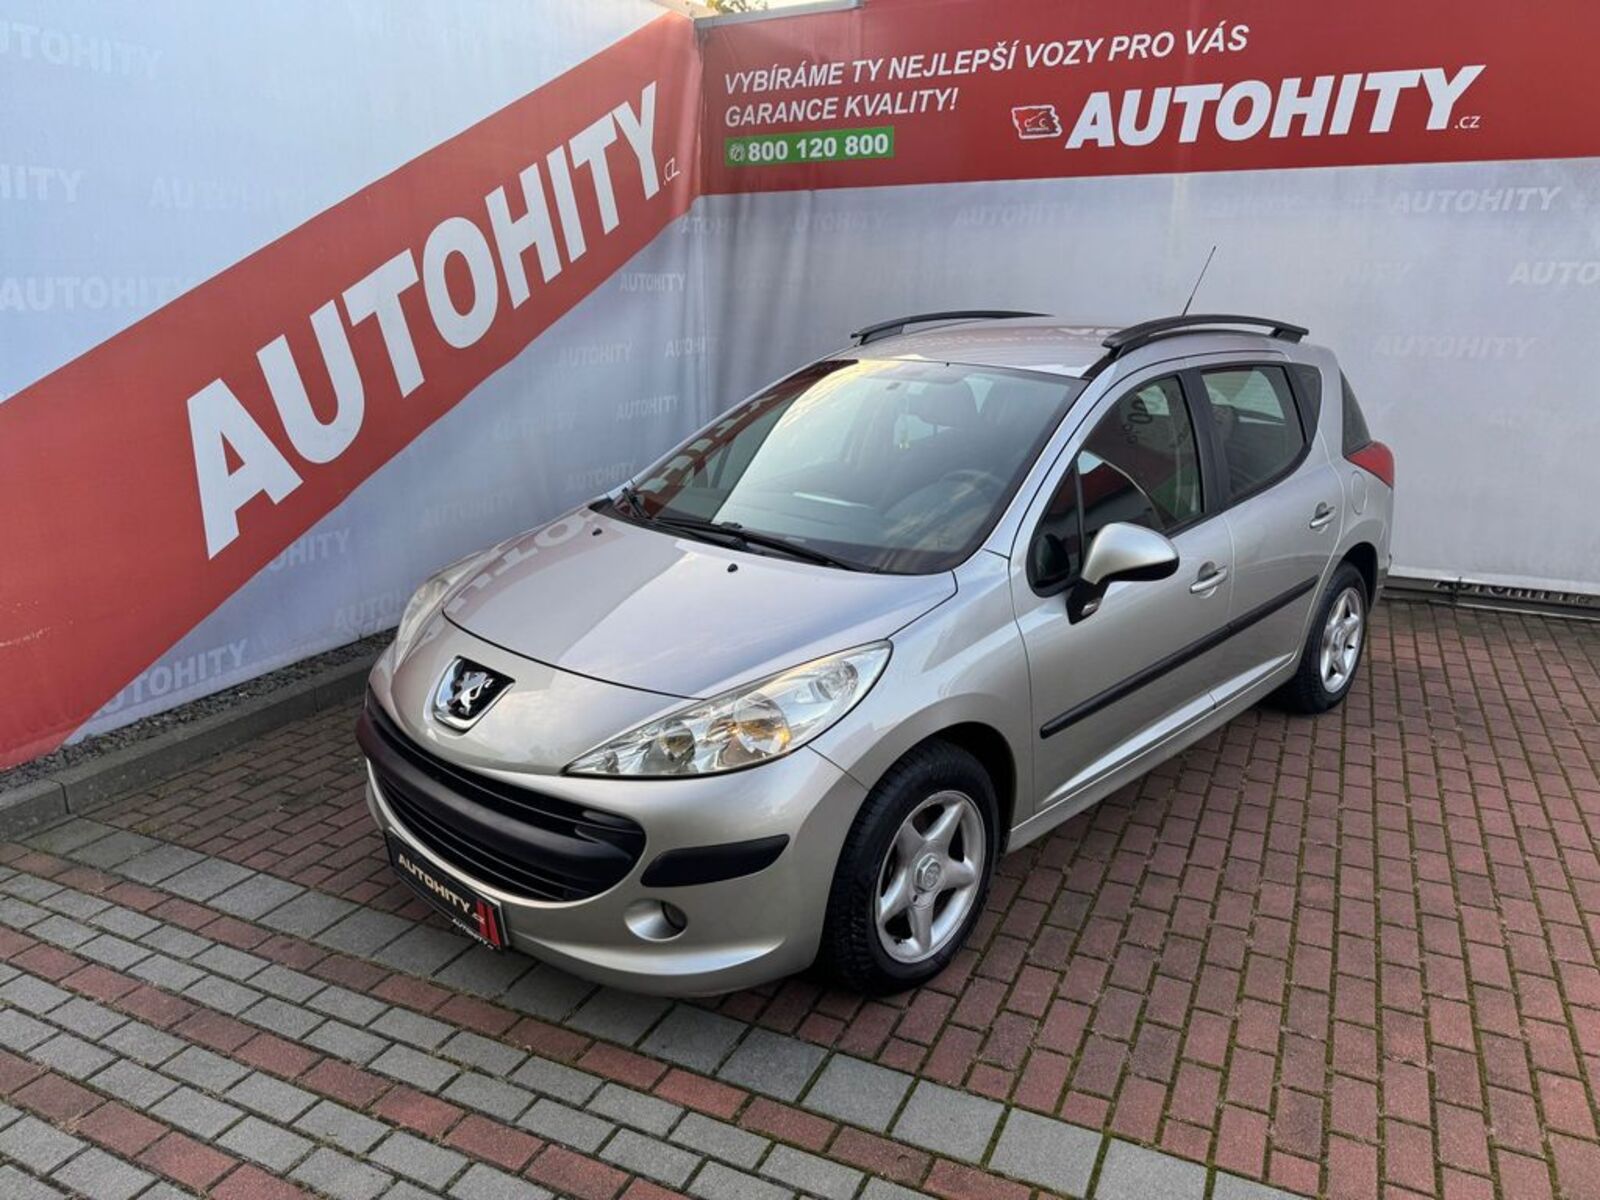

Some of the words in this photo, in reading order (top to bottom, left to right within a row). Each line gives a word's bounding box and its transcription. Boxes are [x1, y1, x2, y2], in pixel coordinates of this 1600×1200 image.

[724, 61, 843, 94] VYBÍRÁME
[852, 58, 883, 83] TY
[888, 40, 1020, 82] NEJLEPŠÍ
[1025, 38, 1104, 69] VOZY
[1108, 31, 1175, 63] PRO
[1185, 21, 1250, 55] VÁS
[725, 96, 838, 128] GARANCE
[844, 87, 959, 119] KVALITY!
[747, 140, 789, 164] 800
[796, 137, 837, 161] 120
[844, 133, 889, 157] 800
[1392, 185, 1562, 215] AUTOHITY
[619, 271, 686, 293] AUTOHITY
